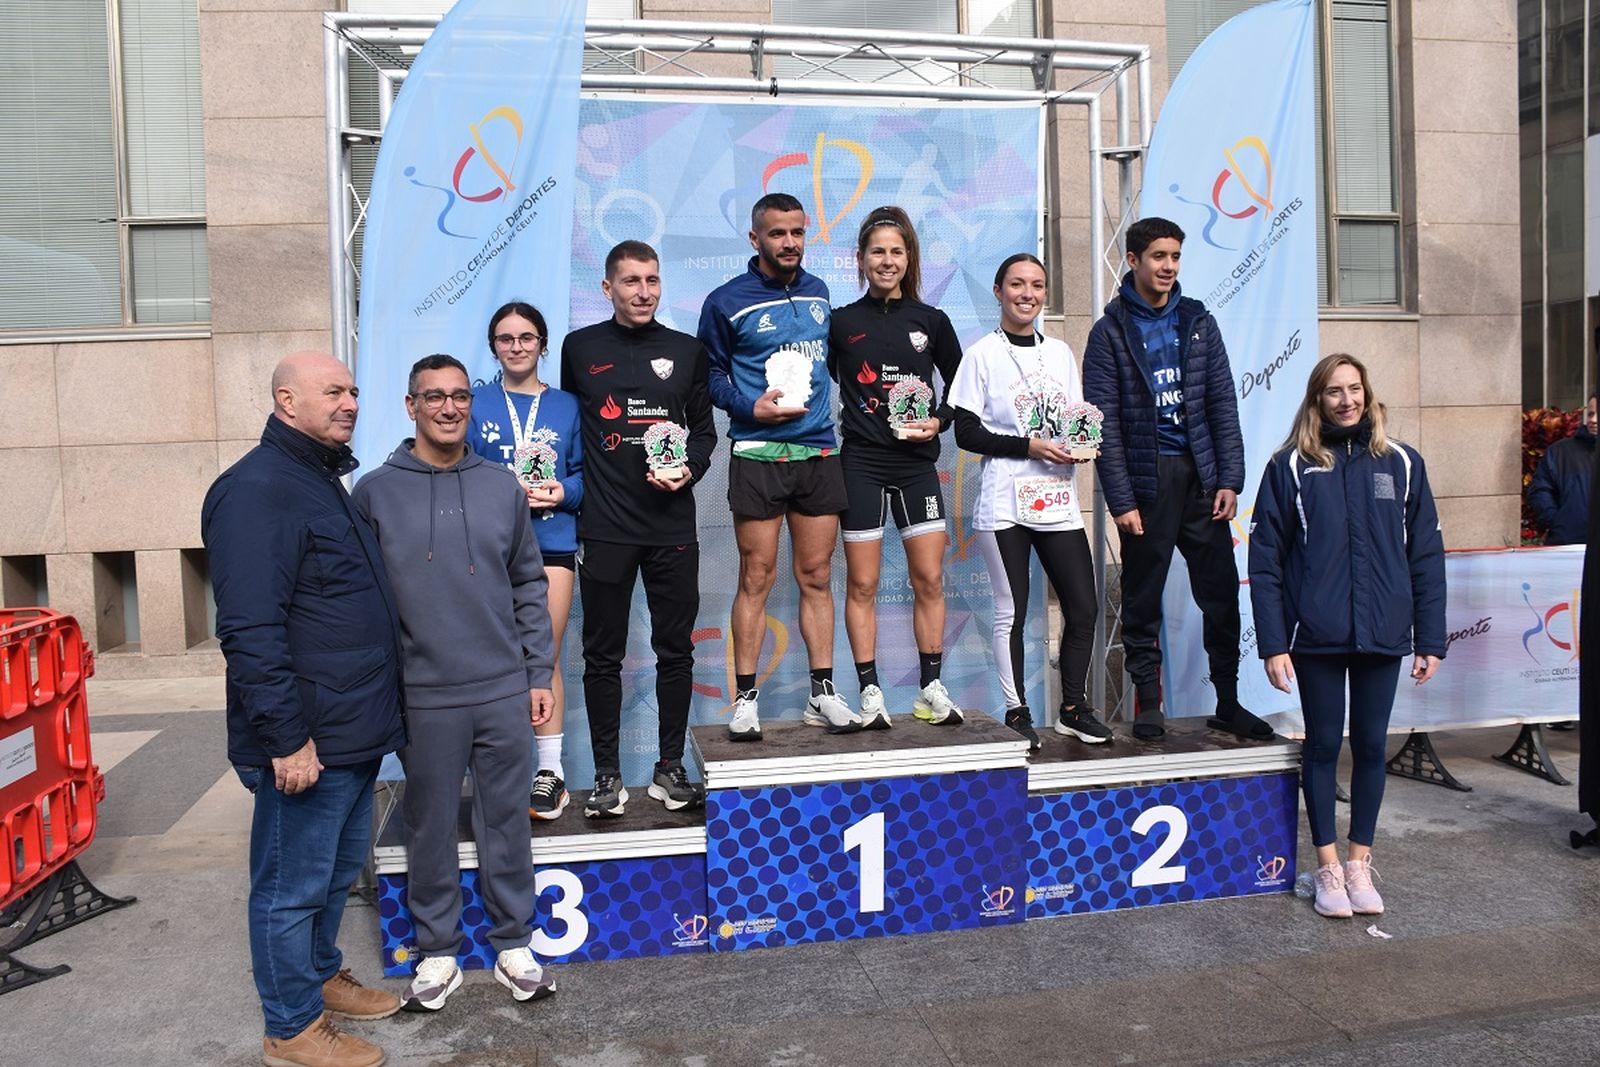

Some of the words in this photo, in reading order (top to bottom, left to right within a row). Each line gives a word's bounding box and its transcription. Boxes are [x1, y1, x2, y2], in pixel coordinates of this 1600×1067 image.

[414, 270, 467, 317] INSTITUTO
[492, 223, 508, 241] DE
[505, 176, 557, 228] DEPORTES
[447, 280, 473, 305] CIUDAD
[516, 211, 538, 232] CEUTA
[684, 256, 749, 270] INSTITUT
[1217, 286, 1241, 309] CIUDAD
[1239, 329, 1302, 399] Deporte
[627, 406, 669, 416] Santander
[1045, 491, 1070, 506] 549
[1446, 616, 1492, 651] porte
[843, 812, 885, 913] 1
[1131, 804, 1188, 888] 2
[528, 868, 589, 957] 3
